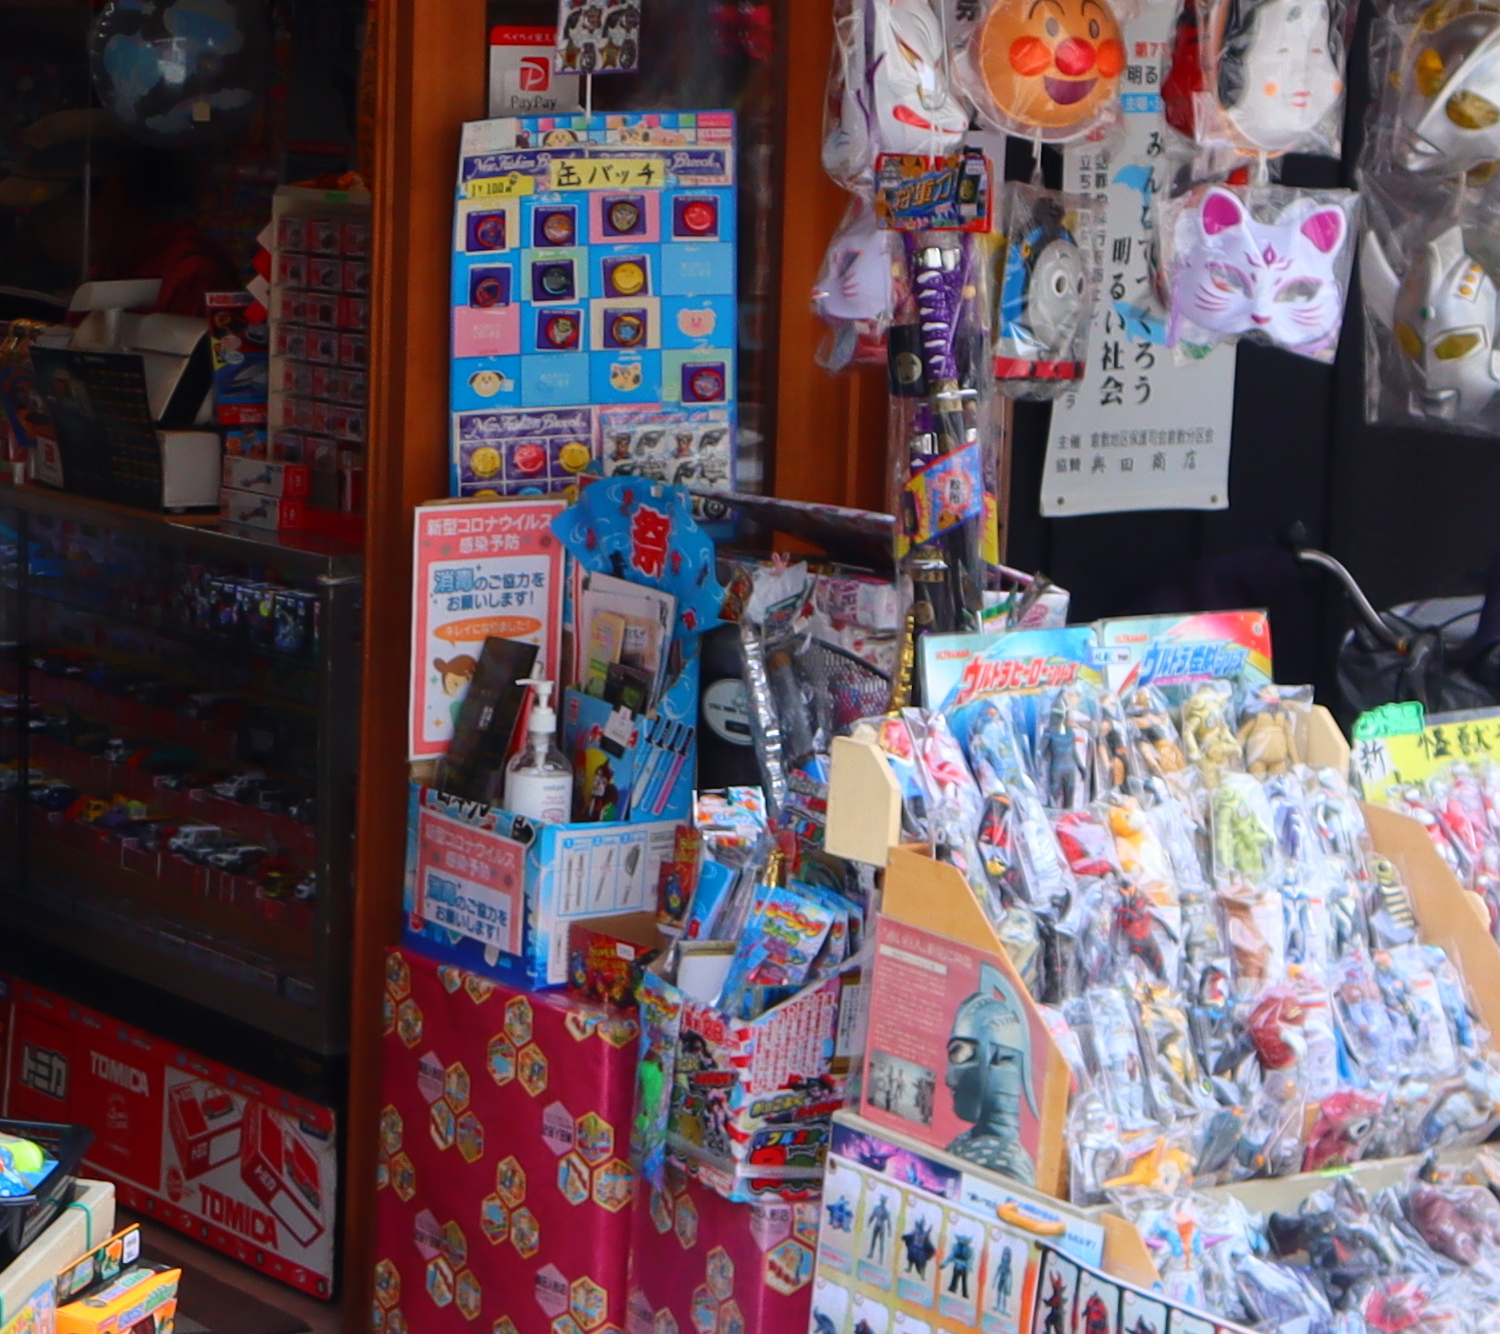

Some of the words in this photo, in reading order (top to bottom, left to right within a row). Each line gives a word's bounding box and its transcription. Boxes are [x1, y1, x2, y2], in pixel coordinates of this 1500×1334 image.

[510, 95, 557, 111] PayPay
[427, 513, 553, 537] 新型コロナウイルス
[459, 534, 521, 554] 感染予防
[434, 568, 546, 593] 消毒のご協力を
[446, 592, 535, 612] お願いします!
[91, 1051, 150, 1098] TOMICA
[199, 1188, 280, 1250] TOMICA
